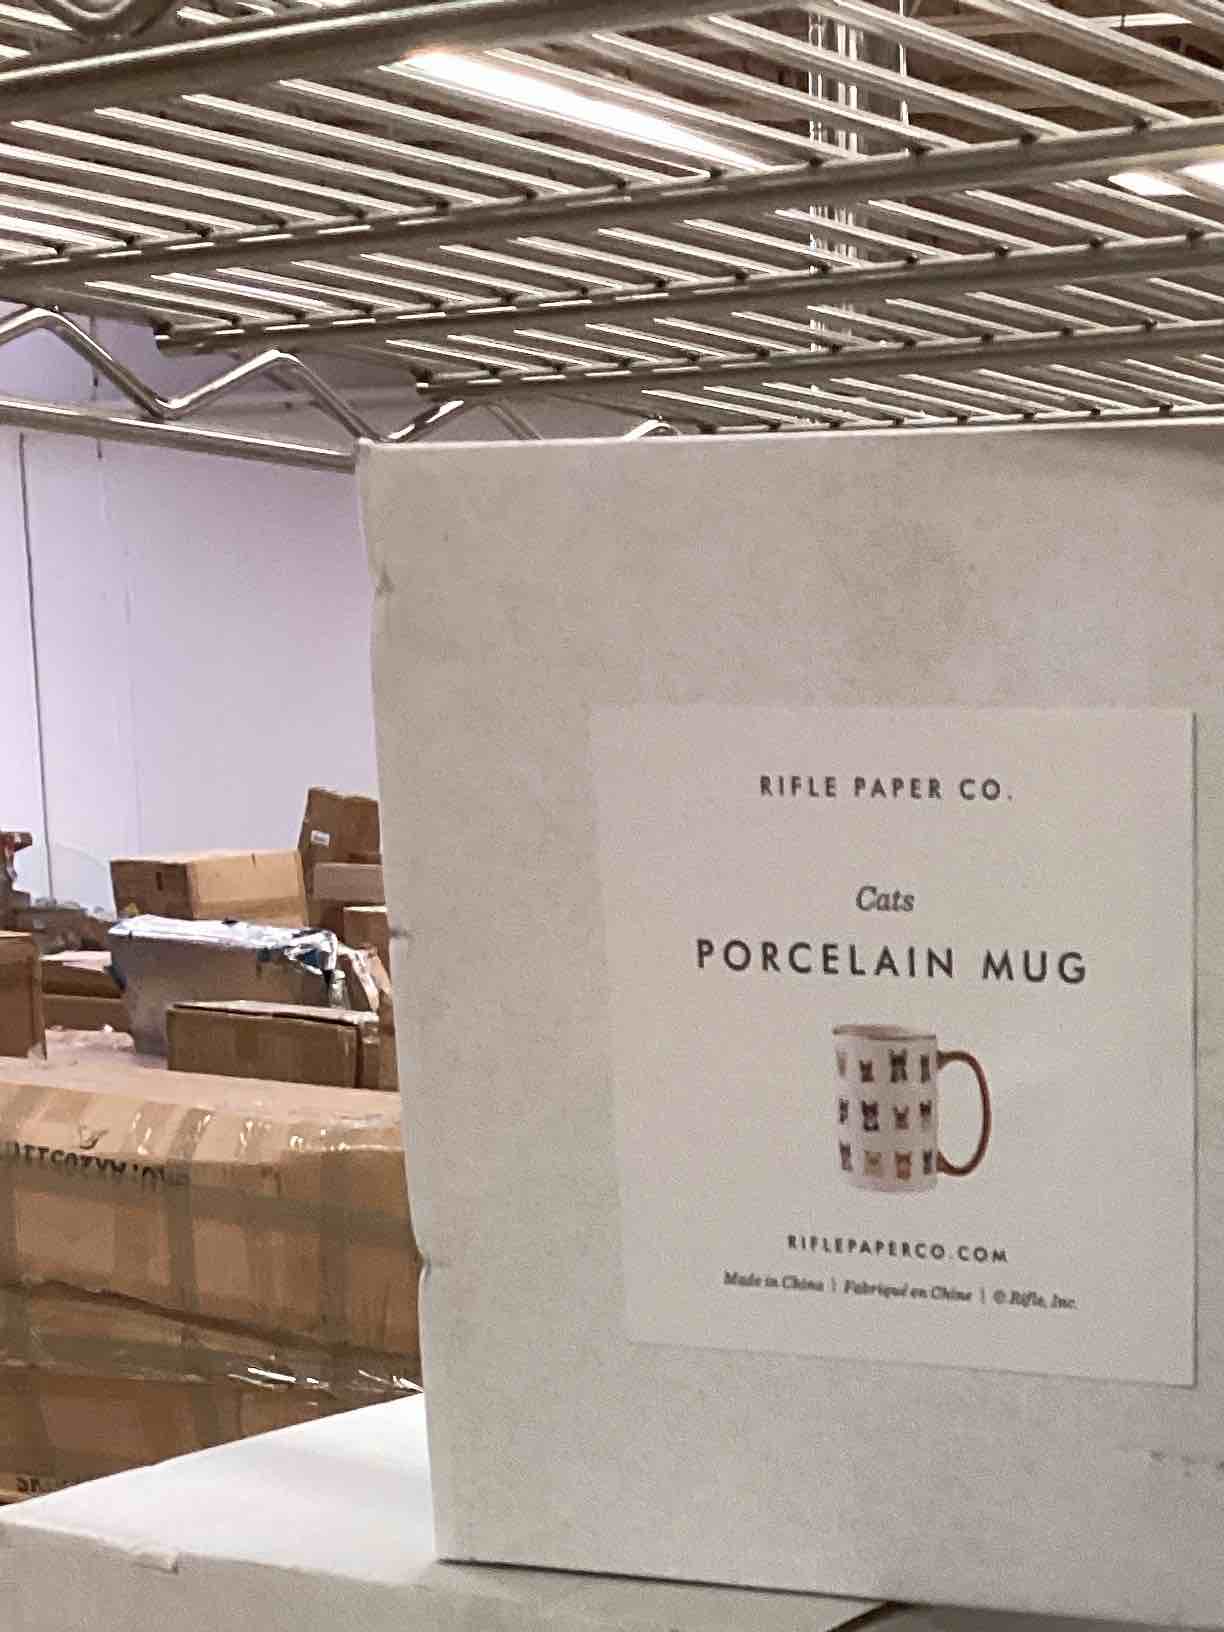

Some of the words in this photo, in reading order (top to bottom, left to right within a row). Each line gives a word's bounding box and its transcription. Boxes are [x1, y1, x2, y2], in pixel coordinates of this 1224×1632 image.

[760, 775, 837, 798] RIFLE
[853, 776, 942, 800] PAPER
[959, 778, 1014, 801] CO.
[855, 885, 915, 912] Cats
[695, 938, 955, 979] PORCELAIN
[982, 948, 1087, 985] MUG
[787, 1234, 1009, 1264] RIFLEPAPERCO.COM
[723, 1270, 762, 1287] Made
[764, 1276, 778, 1288] in
[782, 1275, 825, 1292] China
[910, 1286, 928, 1299] en
